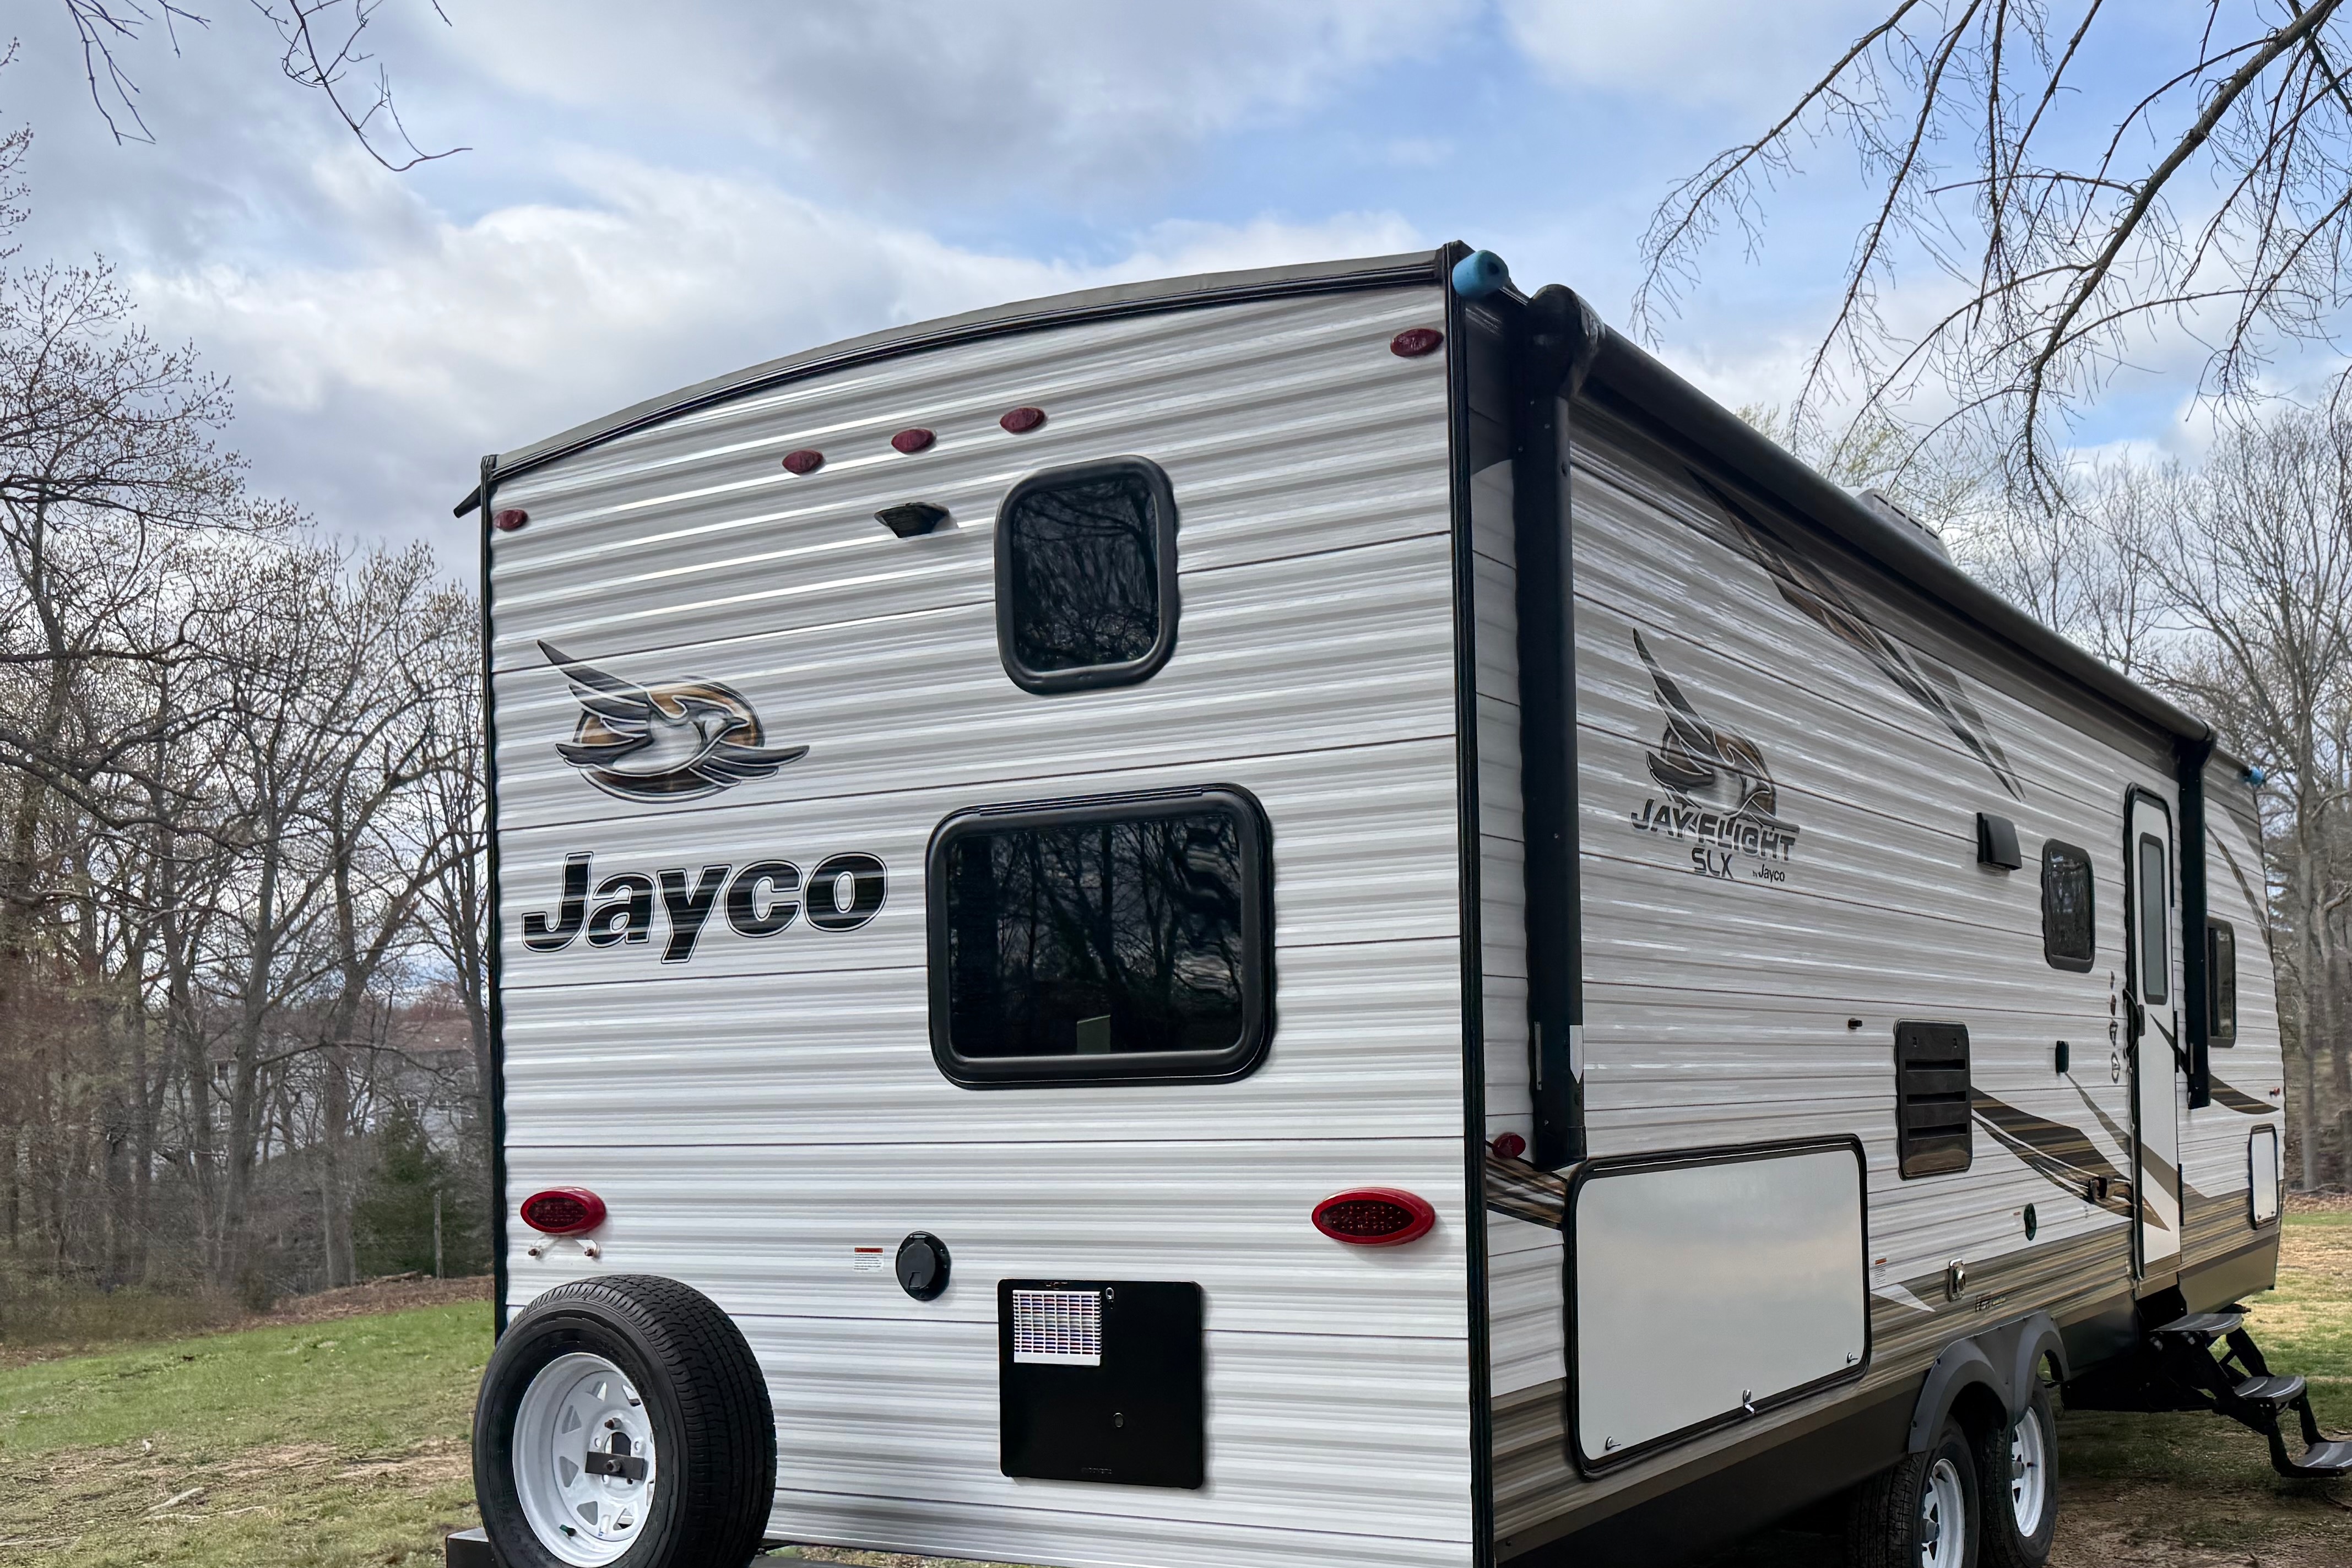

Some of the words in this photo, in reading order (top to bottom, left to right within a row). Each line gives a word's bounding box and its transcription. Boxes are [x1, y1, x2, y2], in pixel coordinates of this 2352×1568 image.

[1692, 847, 1734, 880] SLX
[1758, 864, 1785, 883] Jayco
[522, 851, 888, 964] Jayco
